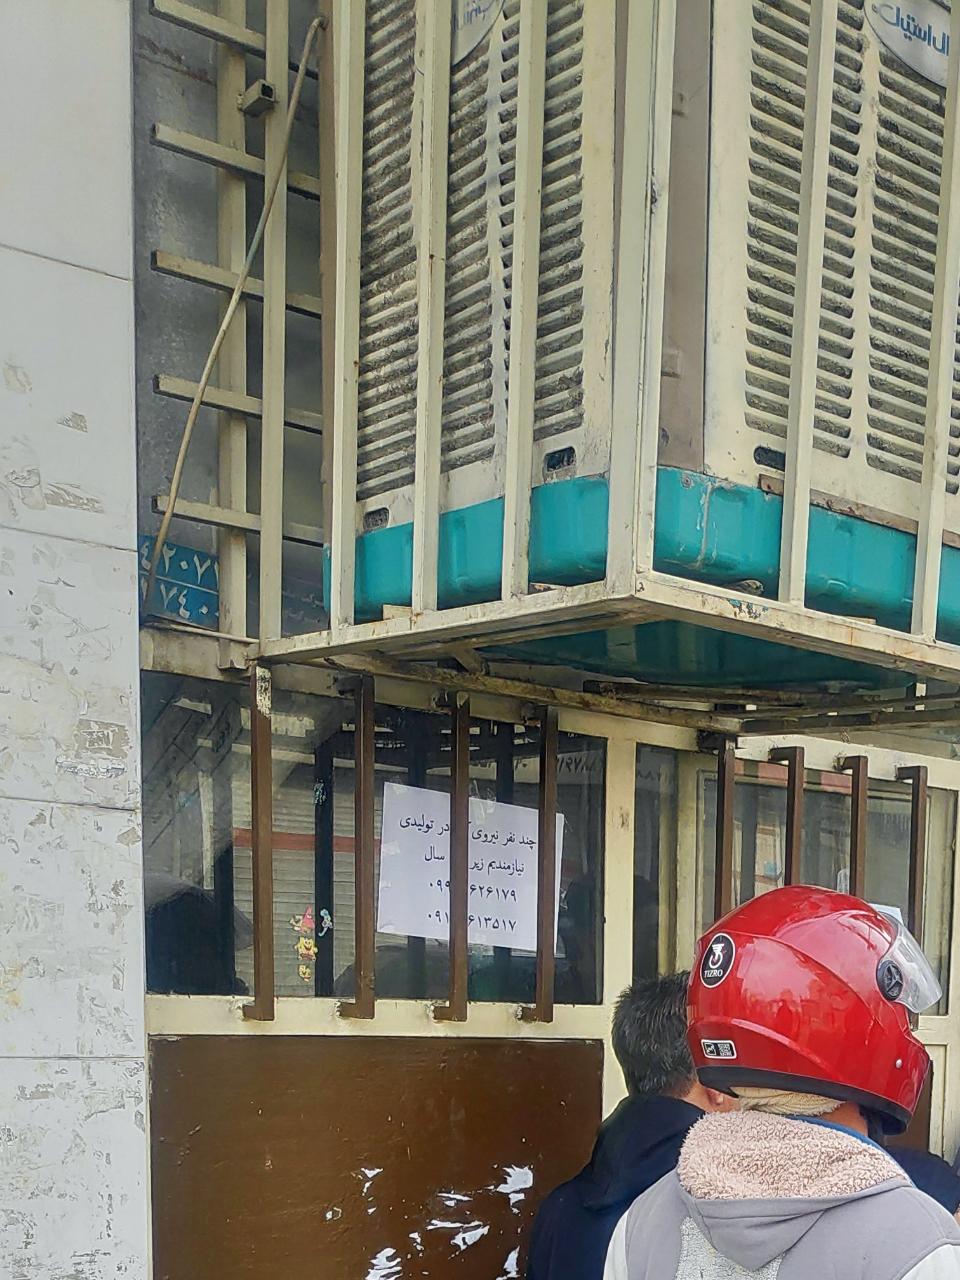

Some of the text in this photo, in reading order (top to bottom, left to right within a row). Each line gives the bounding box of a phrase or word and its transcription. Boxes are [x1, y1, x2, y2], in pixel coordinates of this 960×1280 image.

[399, 814, 537, 850] چند نفر نیروی در تولیدی
[424, 846, 525, 876] نیازمندیم زیر سال
[704, 969, 723, 978] TIZRO
